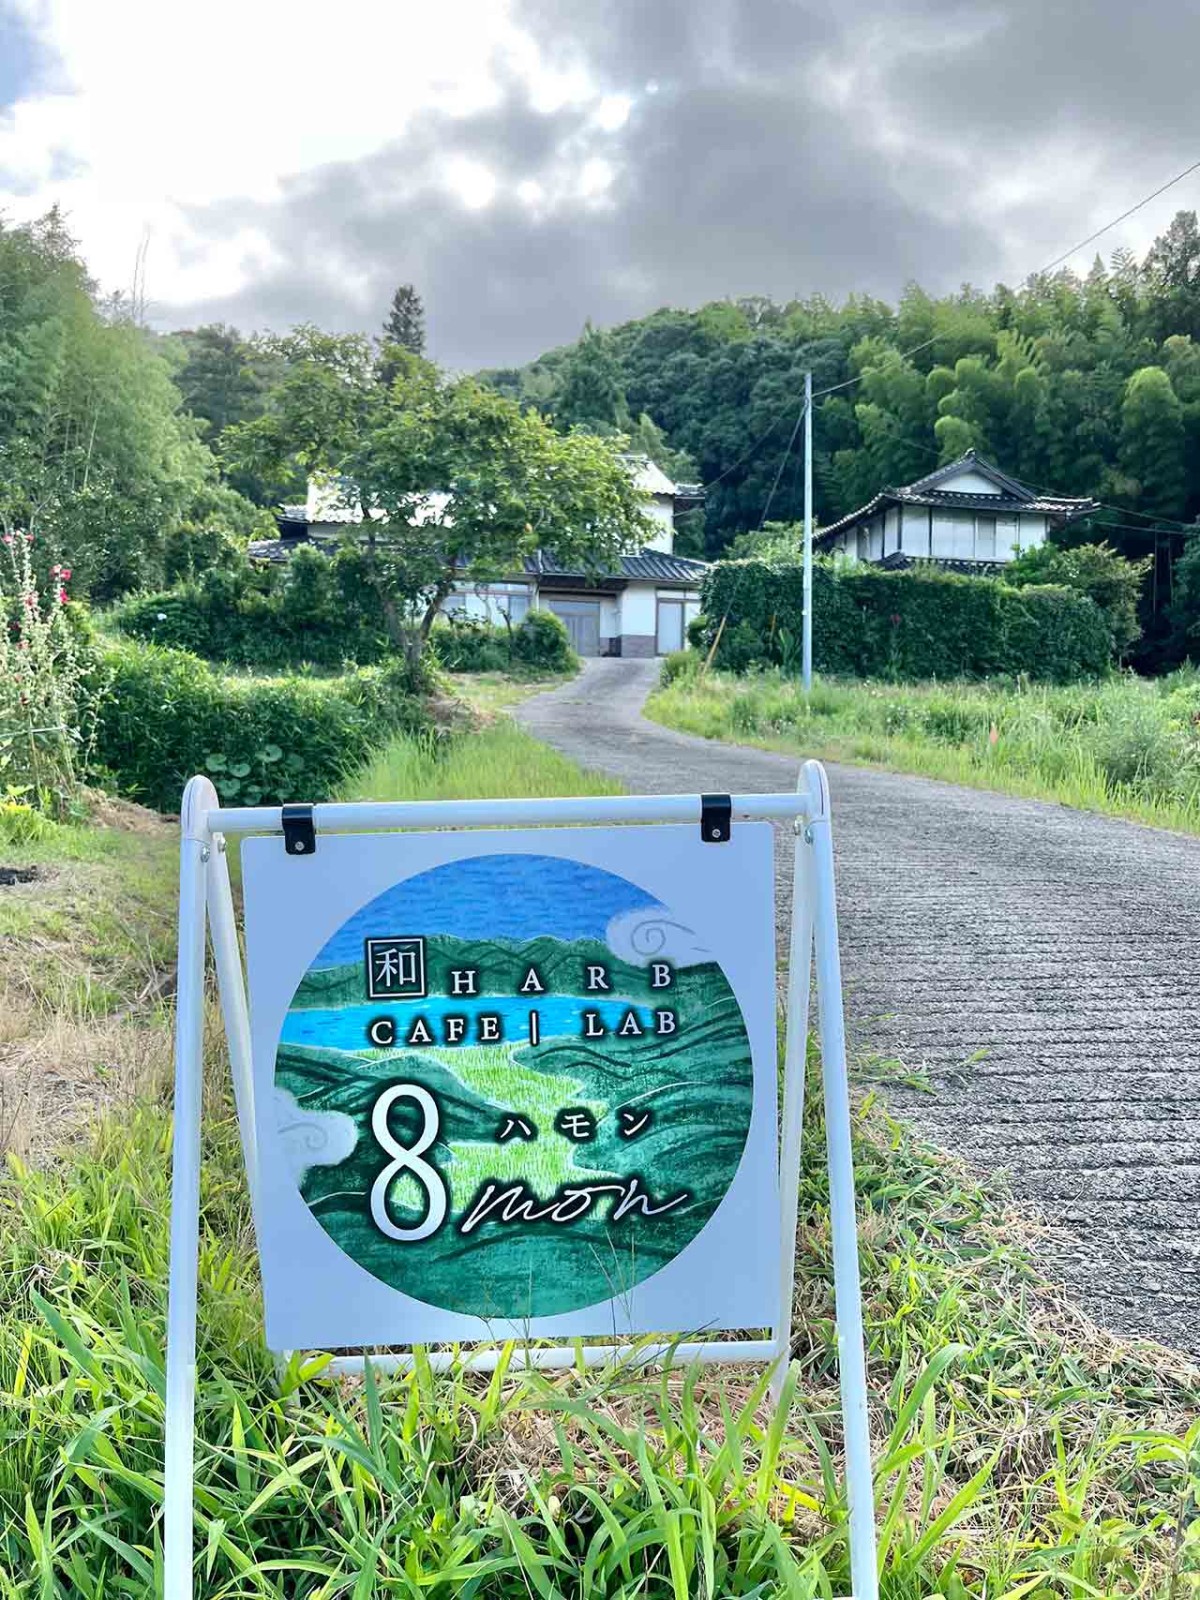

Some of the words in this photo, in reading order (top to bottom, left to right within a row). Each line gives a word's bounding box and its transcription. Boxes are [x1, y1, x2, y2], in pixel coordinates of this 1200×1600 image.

[374, 947, 417, 987] 和
[451, 964, 671, 995] HARB
[371, 1016, 500, 1044] CAFE
[585, 1011, 676, 1037] LAB
[499, 1113, 649, 1138] ハモン
